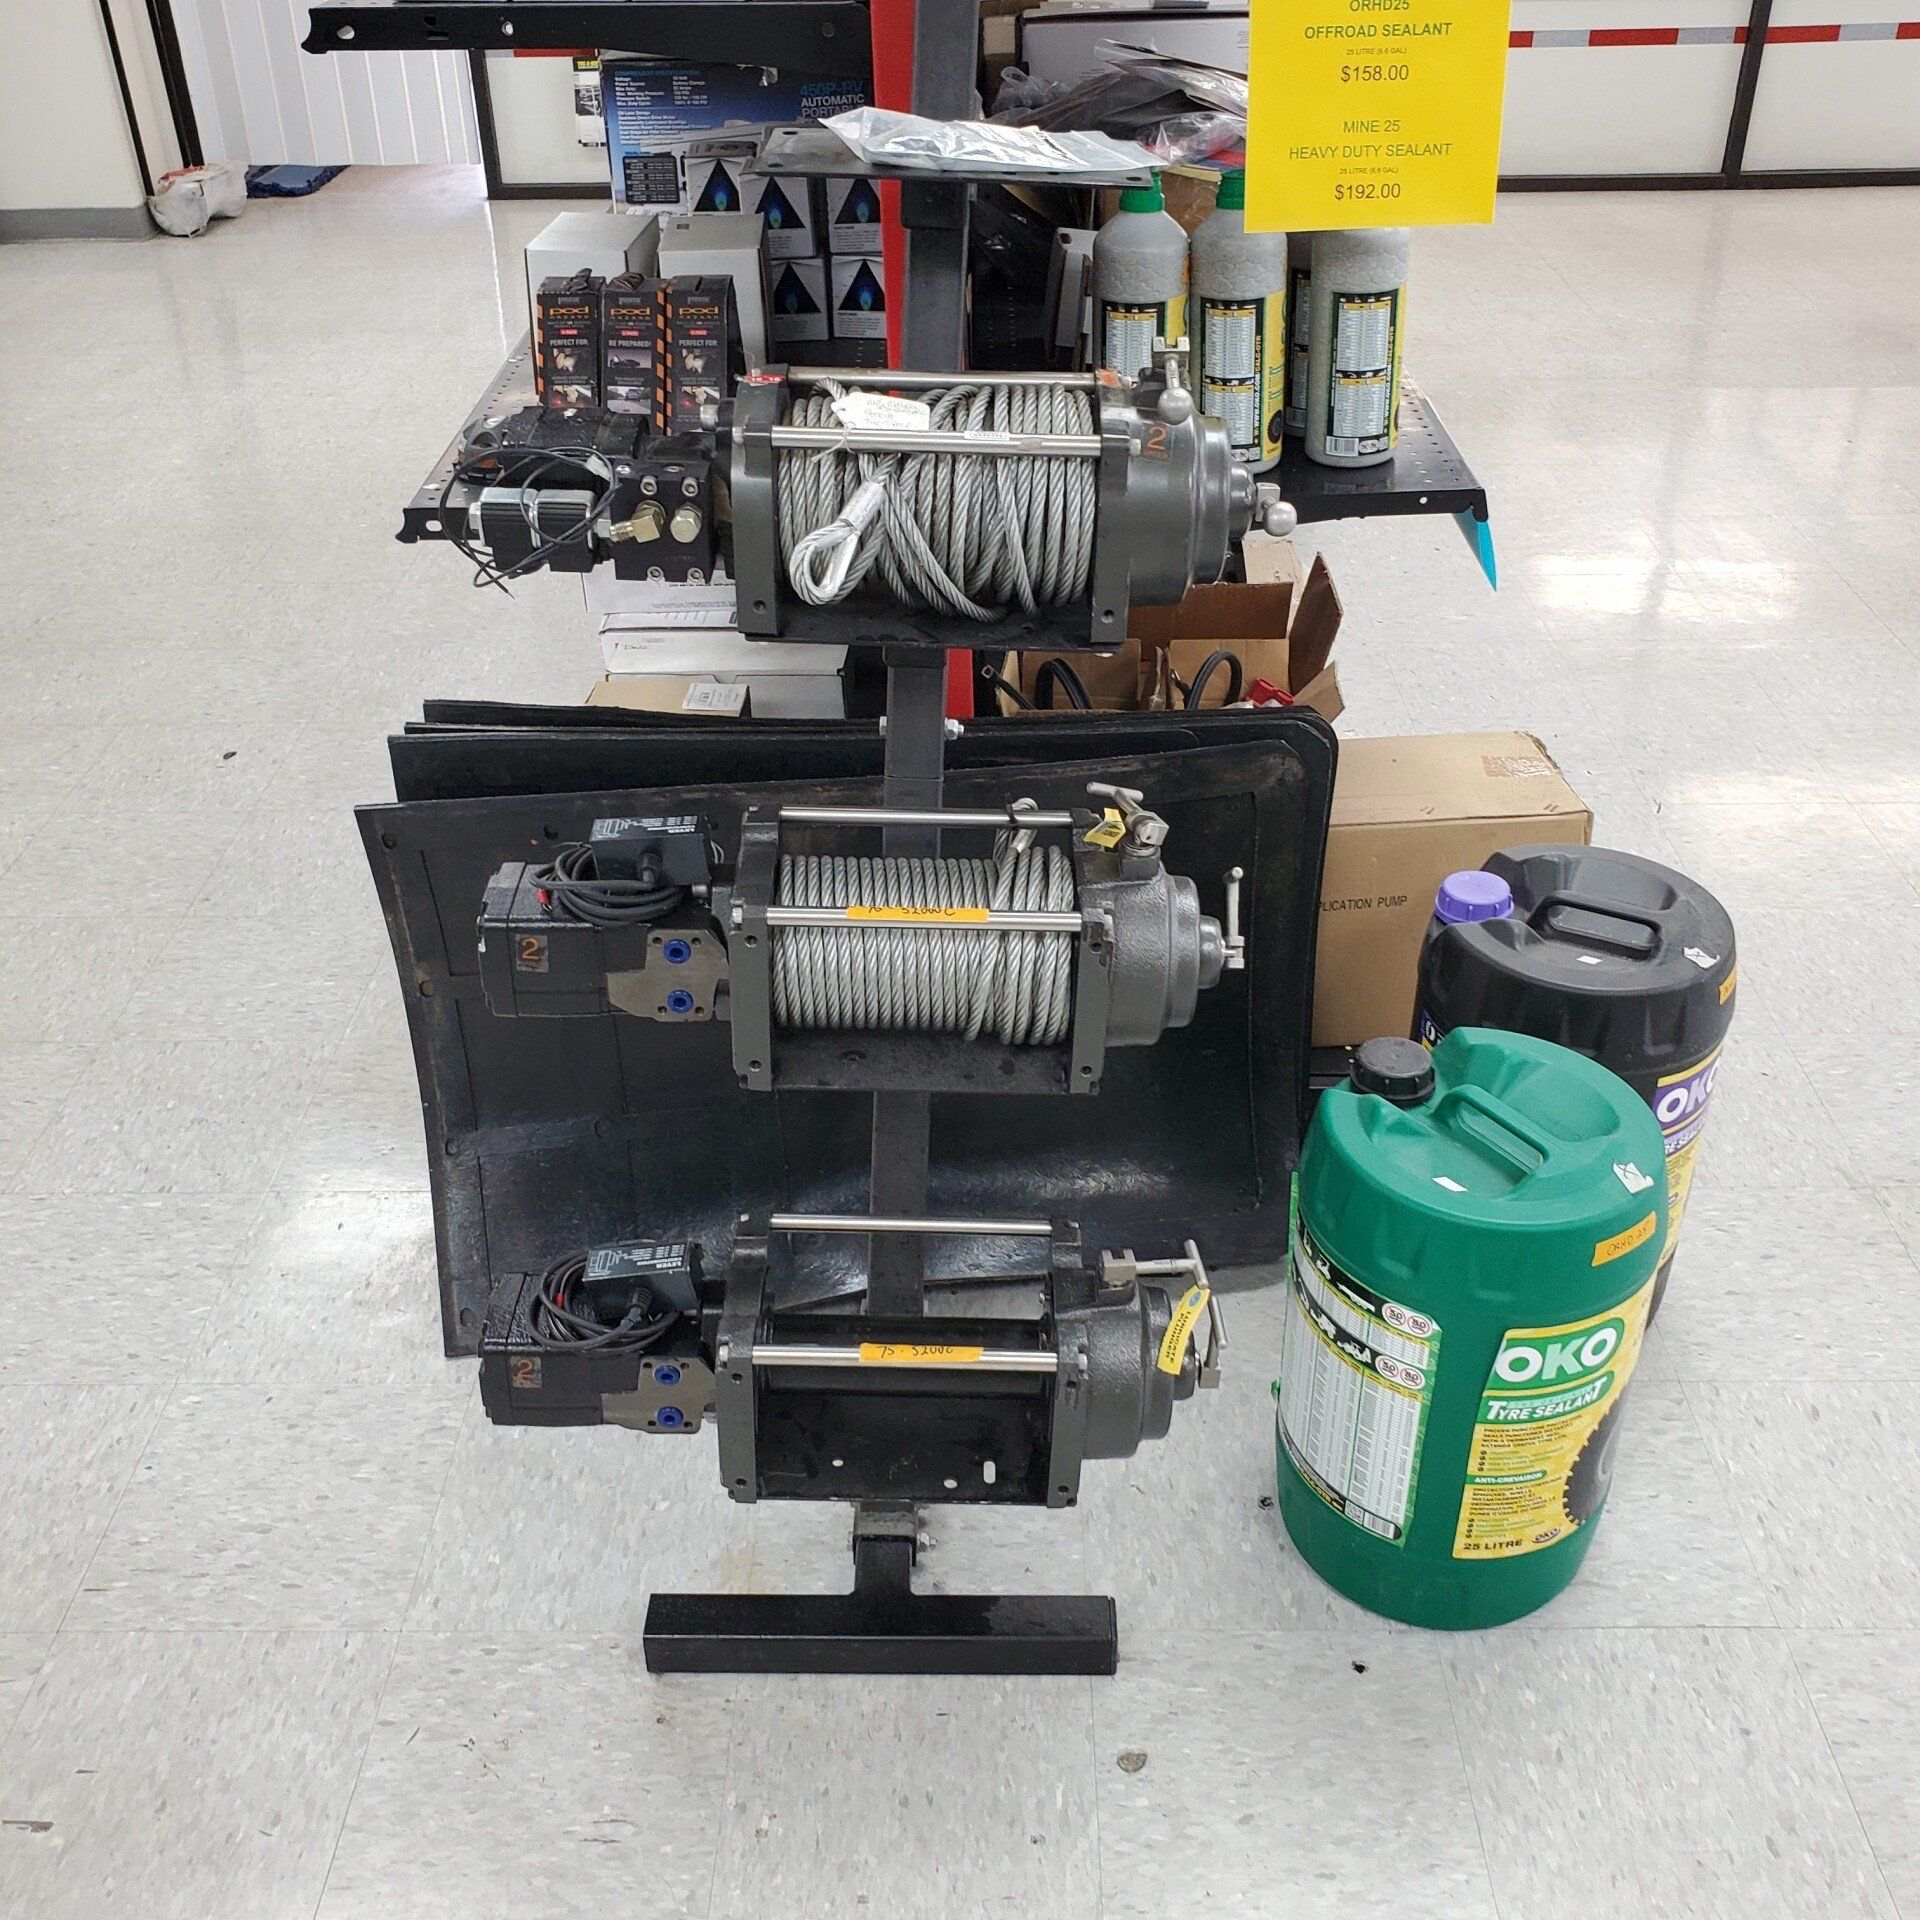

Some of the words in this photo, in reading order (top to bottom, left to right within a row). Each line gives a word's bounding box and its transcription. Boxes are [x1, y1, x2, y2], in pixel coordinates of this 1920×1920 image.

[1350, 0, 1409, 12] ORHD25
[1305, 25, 1377, 39] OFFROAD
[1382, 22, 1452, 37] SEALANT
[1341, 64, 1409, 83] $158.00
[801, 94, 865, 107] AUTOMATIC
[1343, 121, 1380, 133] MINE
[1384, 120, 1400, 132] 25
[1289, 146, 1338, 160] HEAVY
[1342, 144, 1382, 158] DUTY
[1385, 143, 1452, 157] SEALANT
[1334, 183, 1401, 201] $192.00
[550, 306, 590, 316] pod
[610, 307, 650, 316] pod
[679, 306, 718, 315] pod
[1147, 426, 1167, 450] 2
[1320, 898, 1372, 911] LICATION
[1377, 895, 1408, 907] PUMP
[521, 938, 540, 961] 2
[1495, 1327, 1617, 1382] OKO
[517, 1359, 534, 1379] 2
[1487, 1400, 1533, 1420] TYRE
[1533, 1376, 1607, 1418] SEALANT
[1485, 1539, 1523, 1550] LITRE
